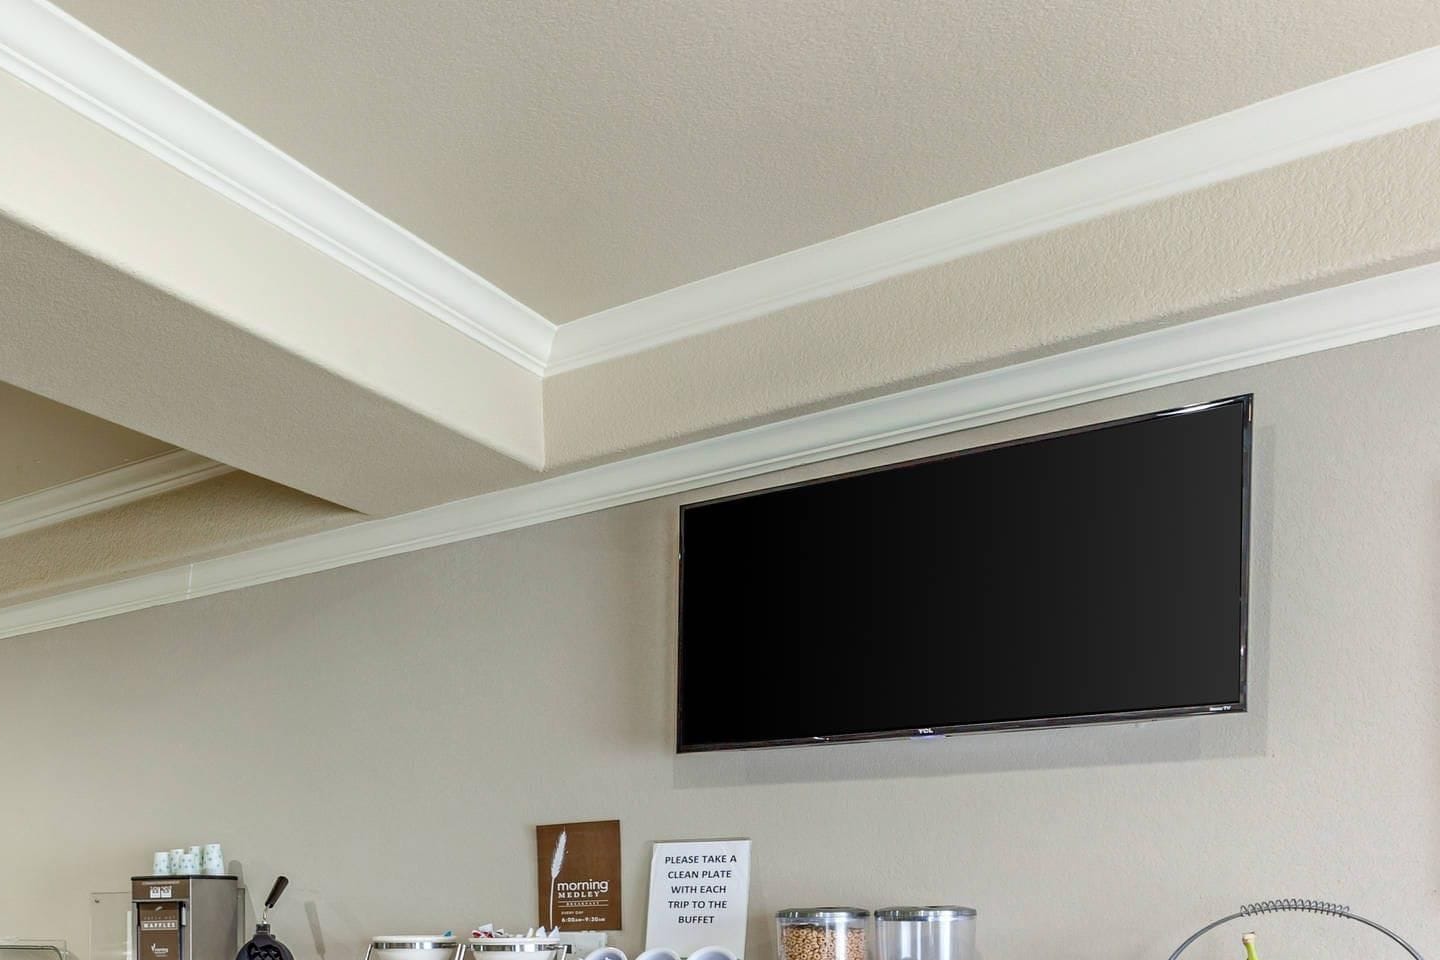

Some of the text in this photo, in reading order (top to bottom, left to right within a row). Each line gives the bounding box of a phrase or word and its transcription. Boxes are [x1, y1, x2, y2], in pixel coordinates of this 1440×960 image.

[665, 855, 737, 864] PLEASE TAKE A
[667, 870, 732, 879] CLEAN PLATE
[557, 878, 609, 893] morning
[671, 885, 727, 894] WITH EACH
[558, 891, 600, 899] MEDLEY
[668, 900, 728, 909] TRIP TO THE
[678, 915, 715, 924] BUFFET
